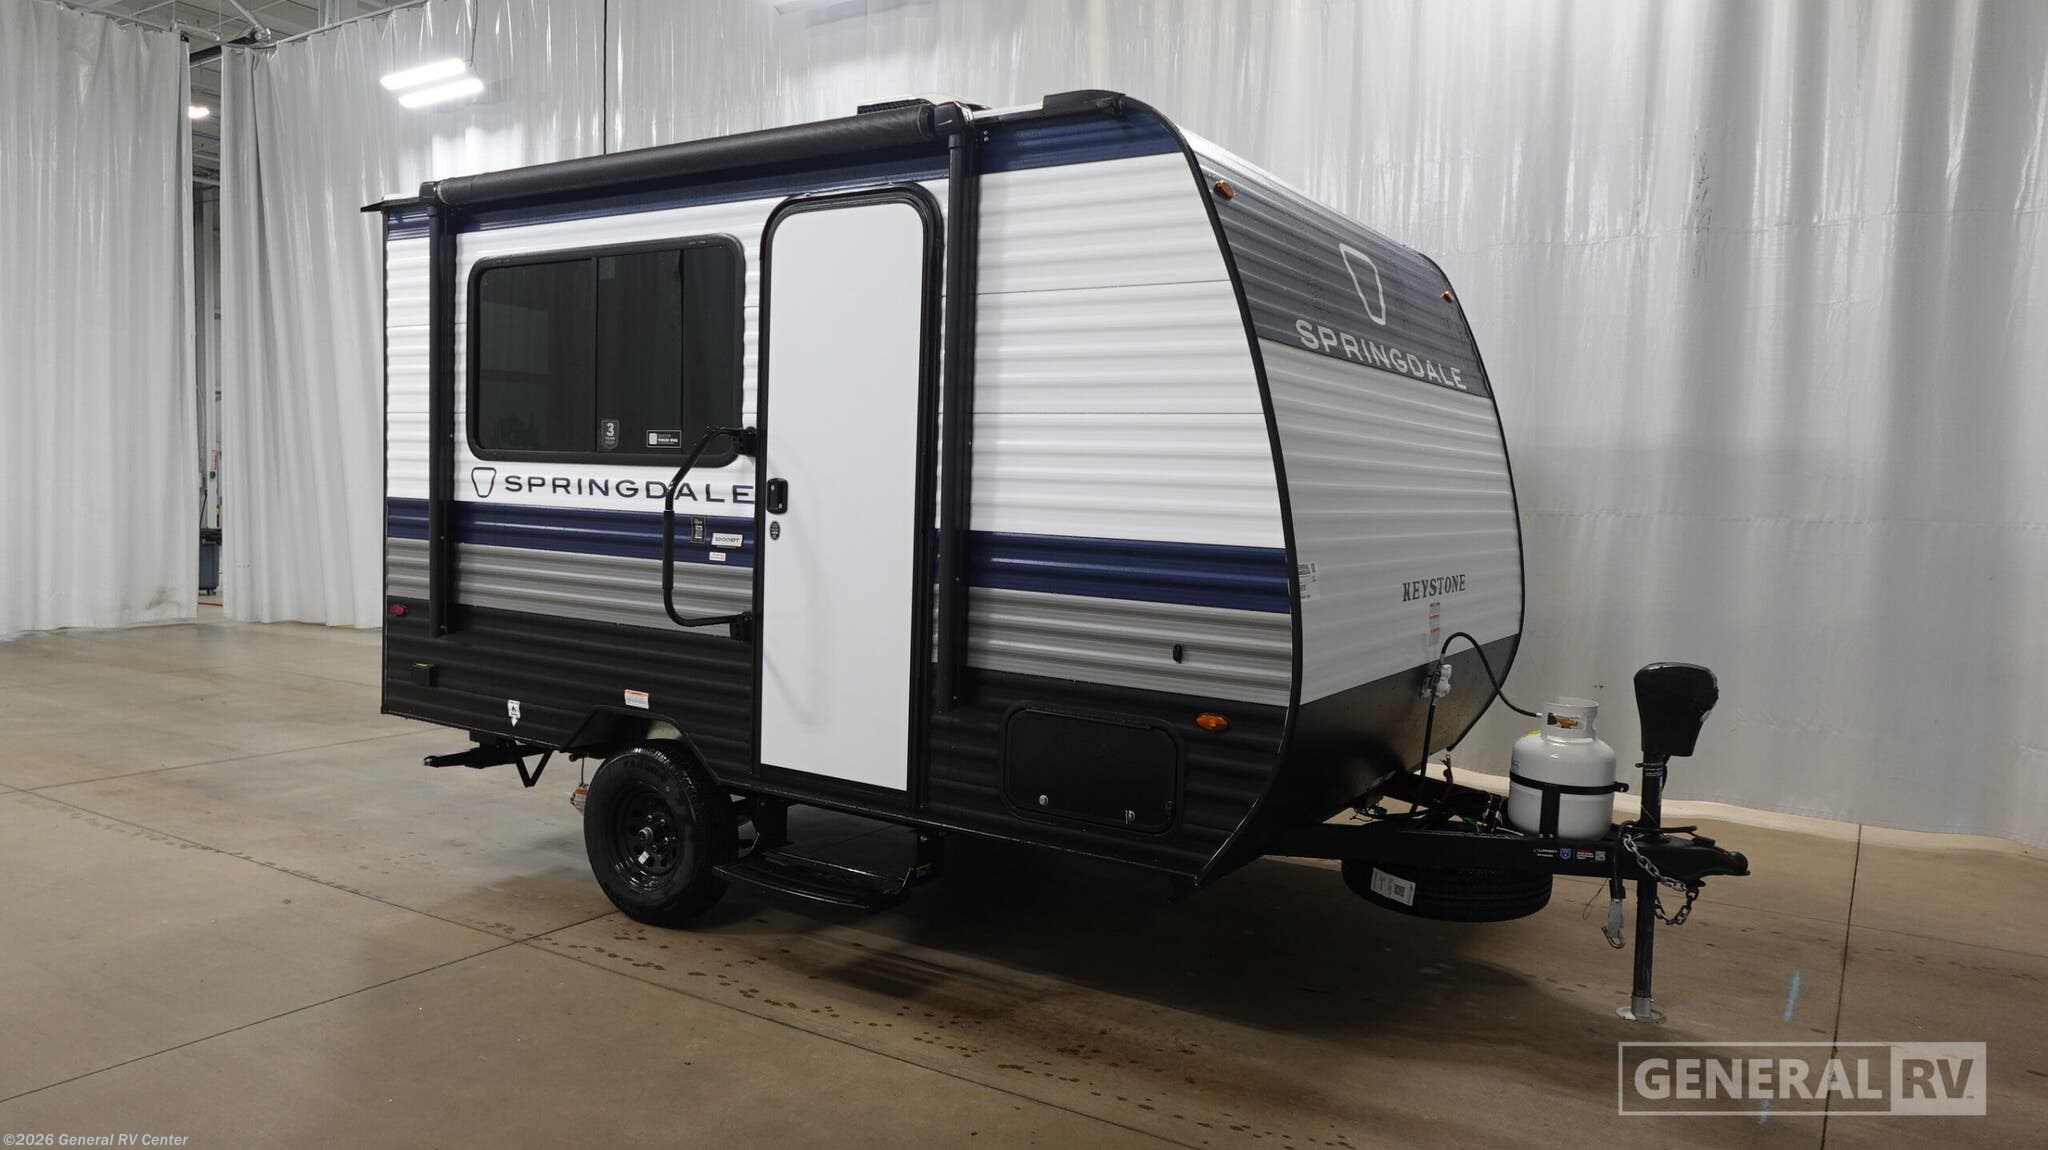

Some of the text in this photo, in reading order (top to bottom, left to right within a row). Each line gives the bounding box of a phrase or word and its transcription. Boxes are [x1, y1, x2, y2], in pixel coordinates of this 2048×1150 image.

[1296, 319, 1467, 390] SPRINGDALE
[606, 422, 615, 437] 3
[504, 475, 755, 504] SPRINGDALE
[1402, 574, 1466, 602] KEYSTONE
